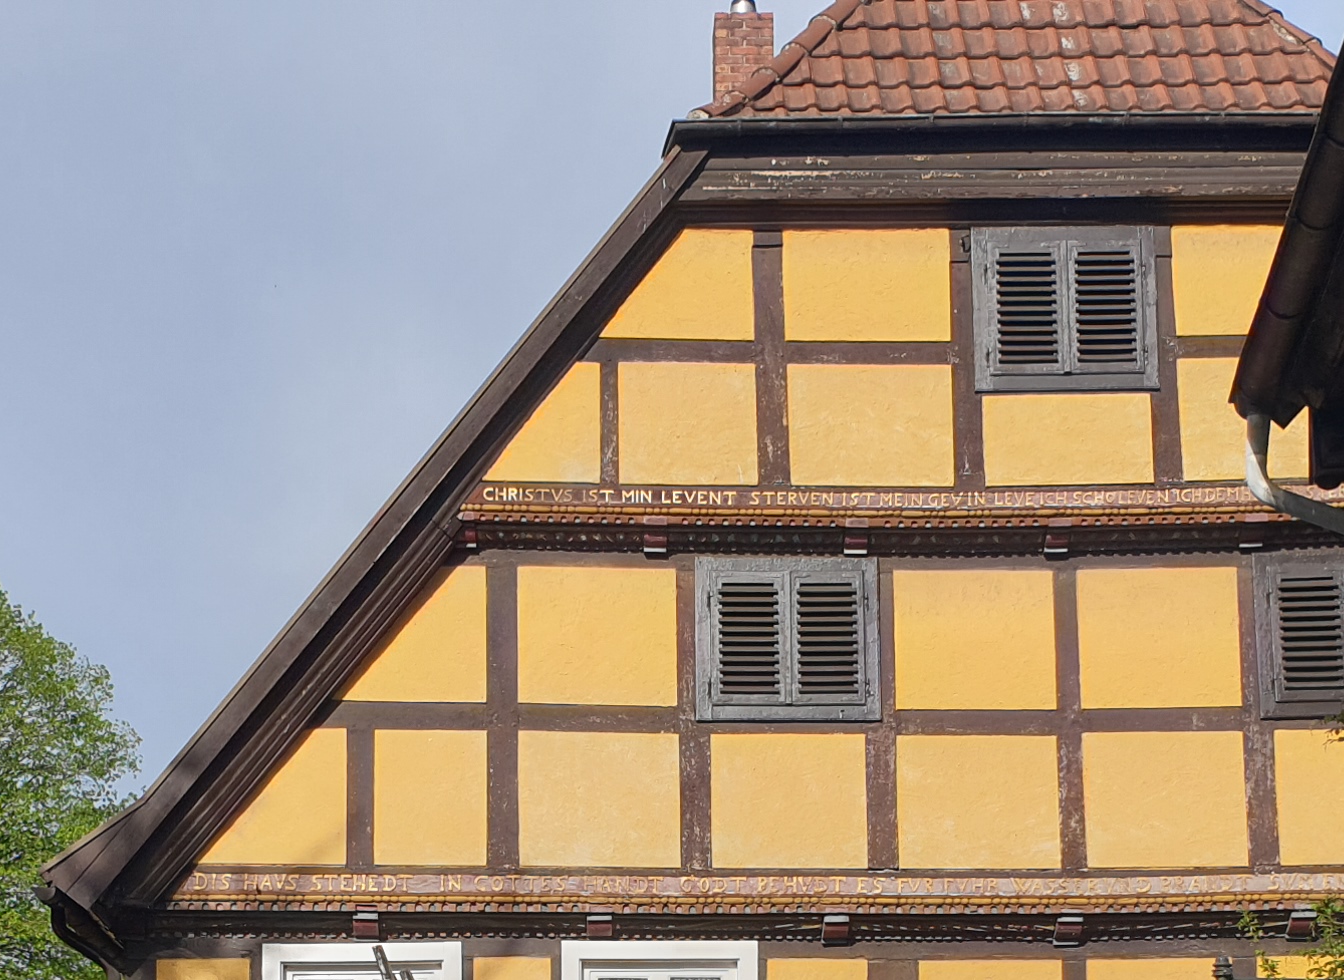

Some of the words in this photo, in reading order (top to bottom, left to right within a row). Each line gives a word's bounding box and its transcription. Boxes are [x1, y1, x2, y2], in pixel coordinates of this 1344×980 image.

[483, 487, 573, 502] CHRISTVS
[582, 488, 614, 503] IST
[621, 489, 653, 503] MIN
[661, 490, 737, 505] LEVENT
[749, 491, 834, 506] STERVEN
[841, 491, 879, 507] IST
[880, 492, 923, 507] MEIN
[1174, 488, 1203, 504] ICH
[192, 873, 232, 891] DIS
[243, 873, 301, 891] HAVS
[310, 874, 415, 892] STEHEDT
[439, 874, 463, 891] IN
[856, 876, 887, 894] ES
